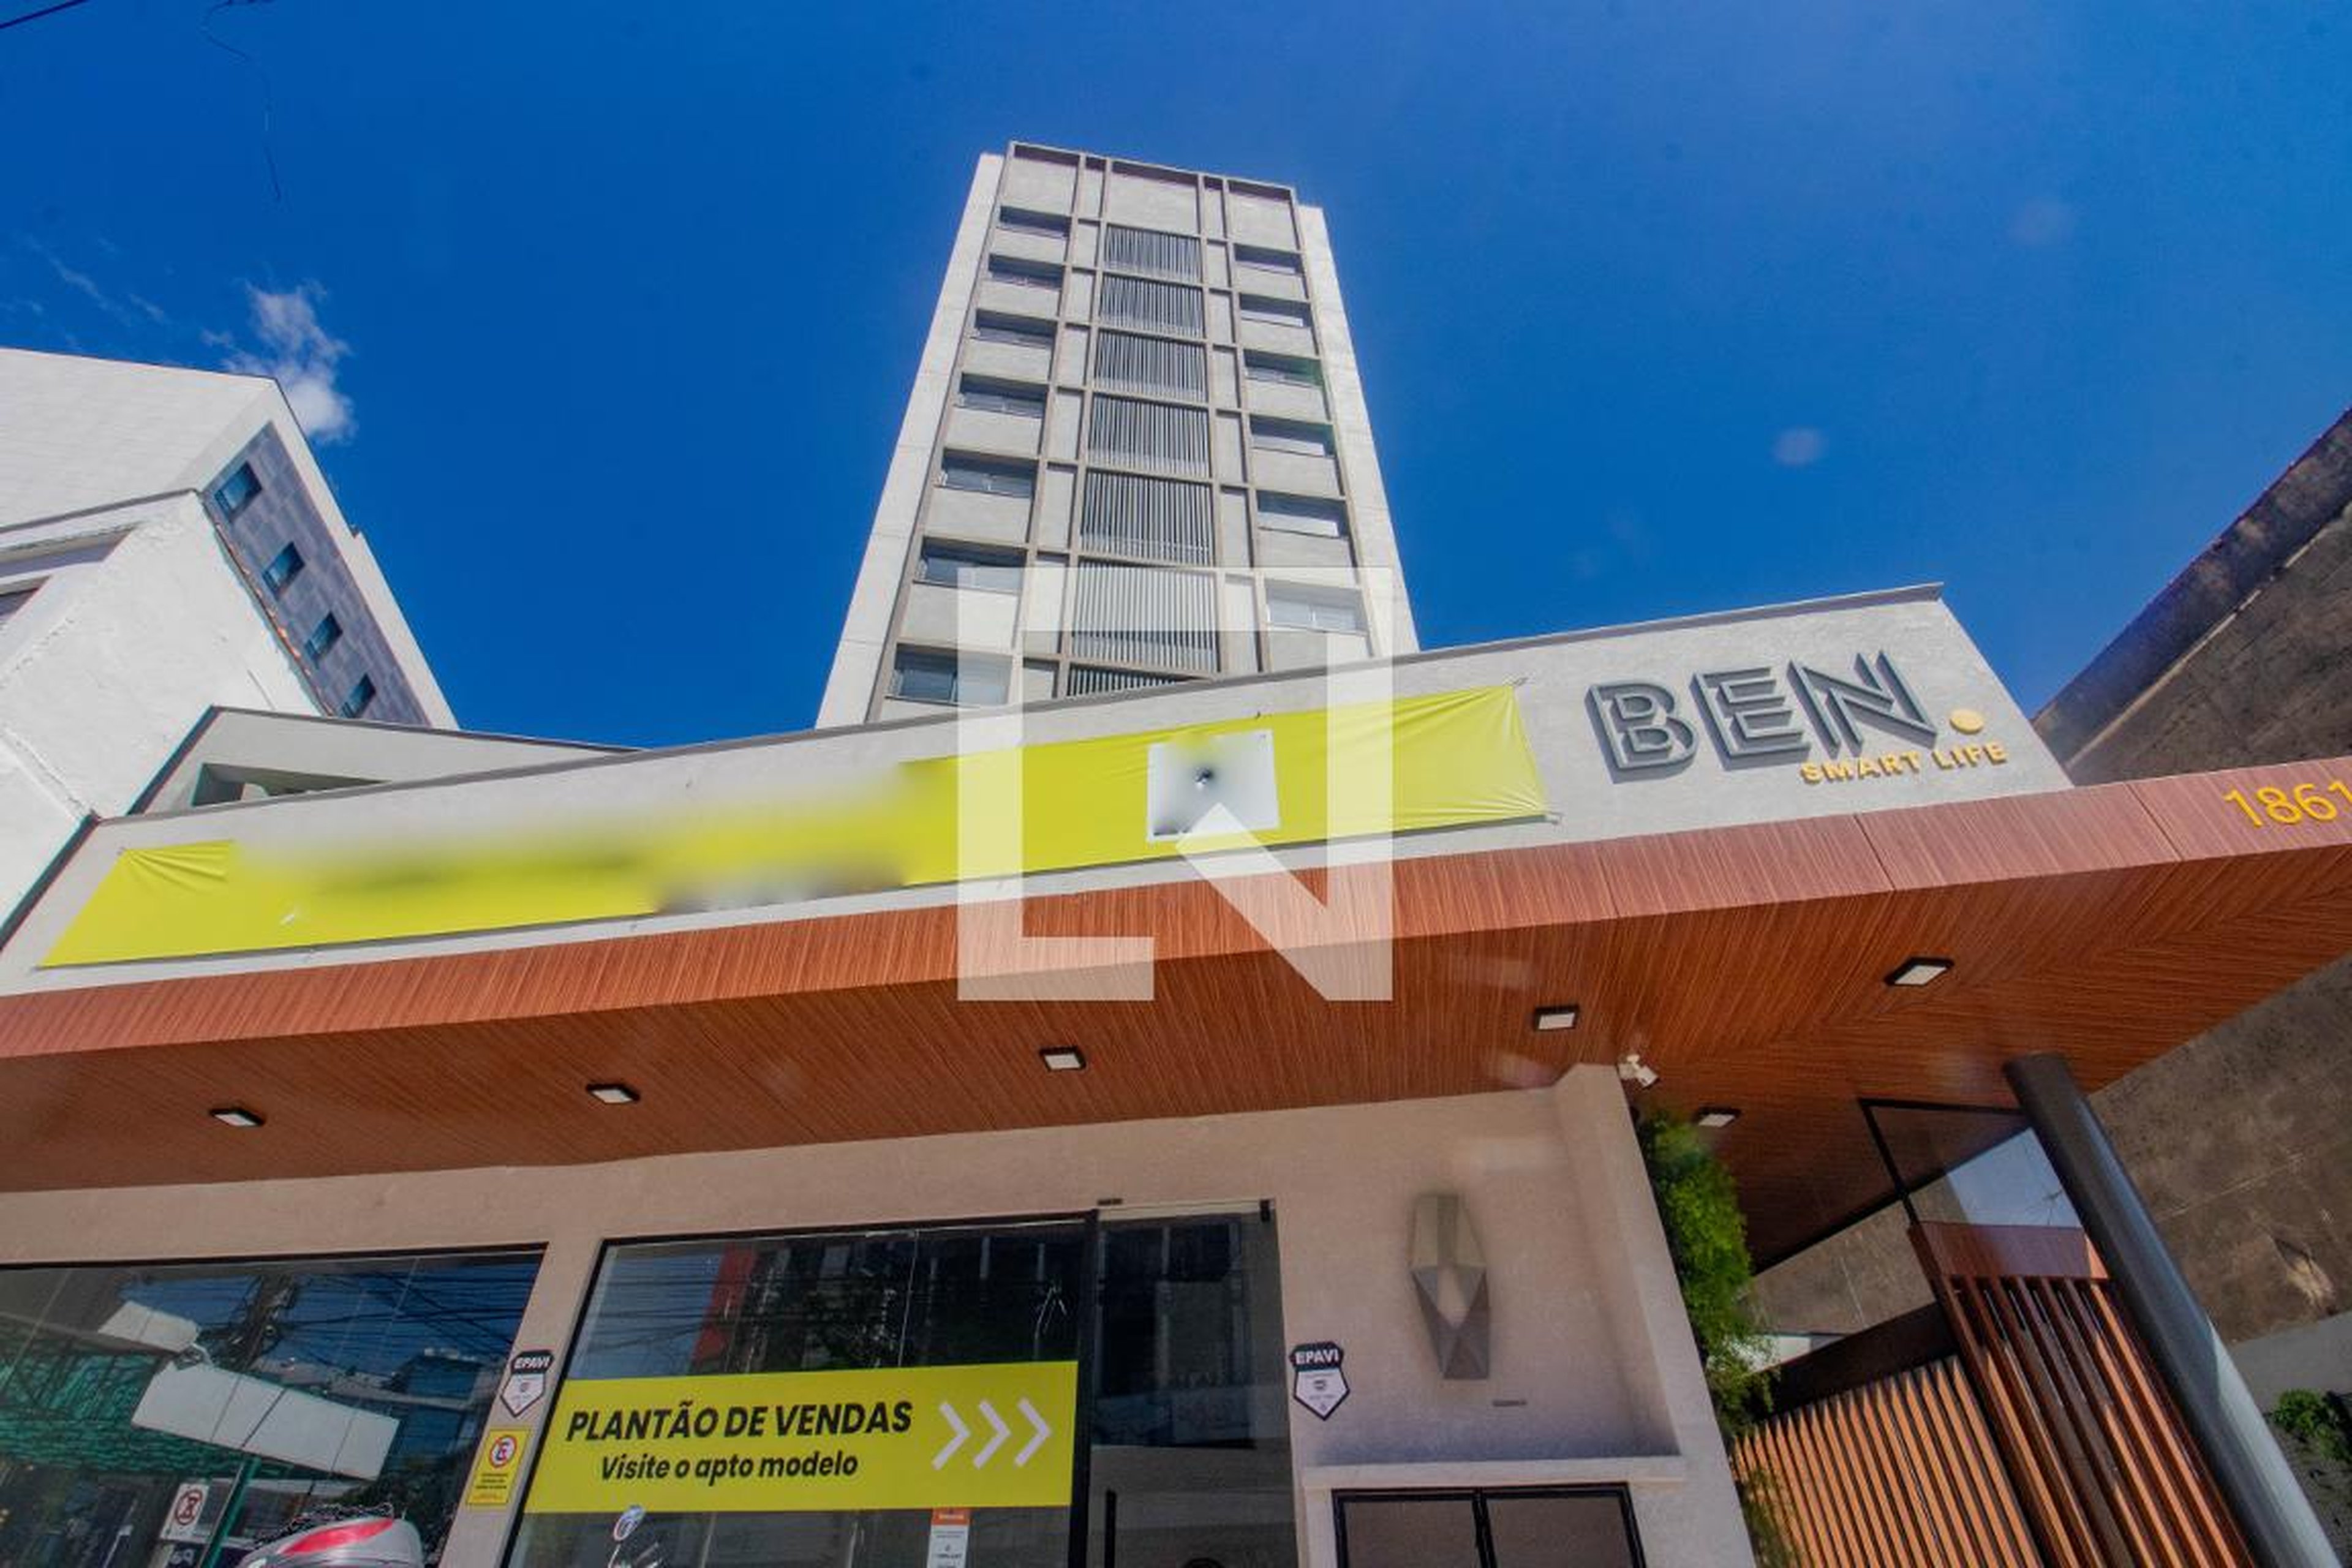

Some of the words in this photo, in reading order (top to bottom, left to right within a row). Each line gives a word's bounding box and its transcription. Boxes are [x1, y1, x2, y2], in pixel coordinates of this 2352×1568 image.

[1800, 750, 1921, 784] SMART
[1931, 741, 2008, 770] LIFE
[514, 1355, 551, 1369] EPAVI
[1295, 1349, 1340, 1365] EPAVI
[566, 1400, 719, 1441] PLANTÃO
[724, 1406, 767, 1437] DE
[775, 1401, 913, 1436] VENDAS
[602, 1453, 670, 1480] Visite
[676, 1460, 690, 1478] o
[695, 1454, 753, 1487] apto
[759, 1450, 858, 1478] modelo
